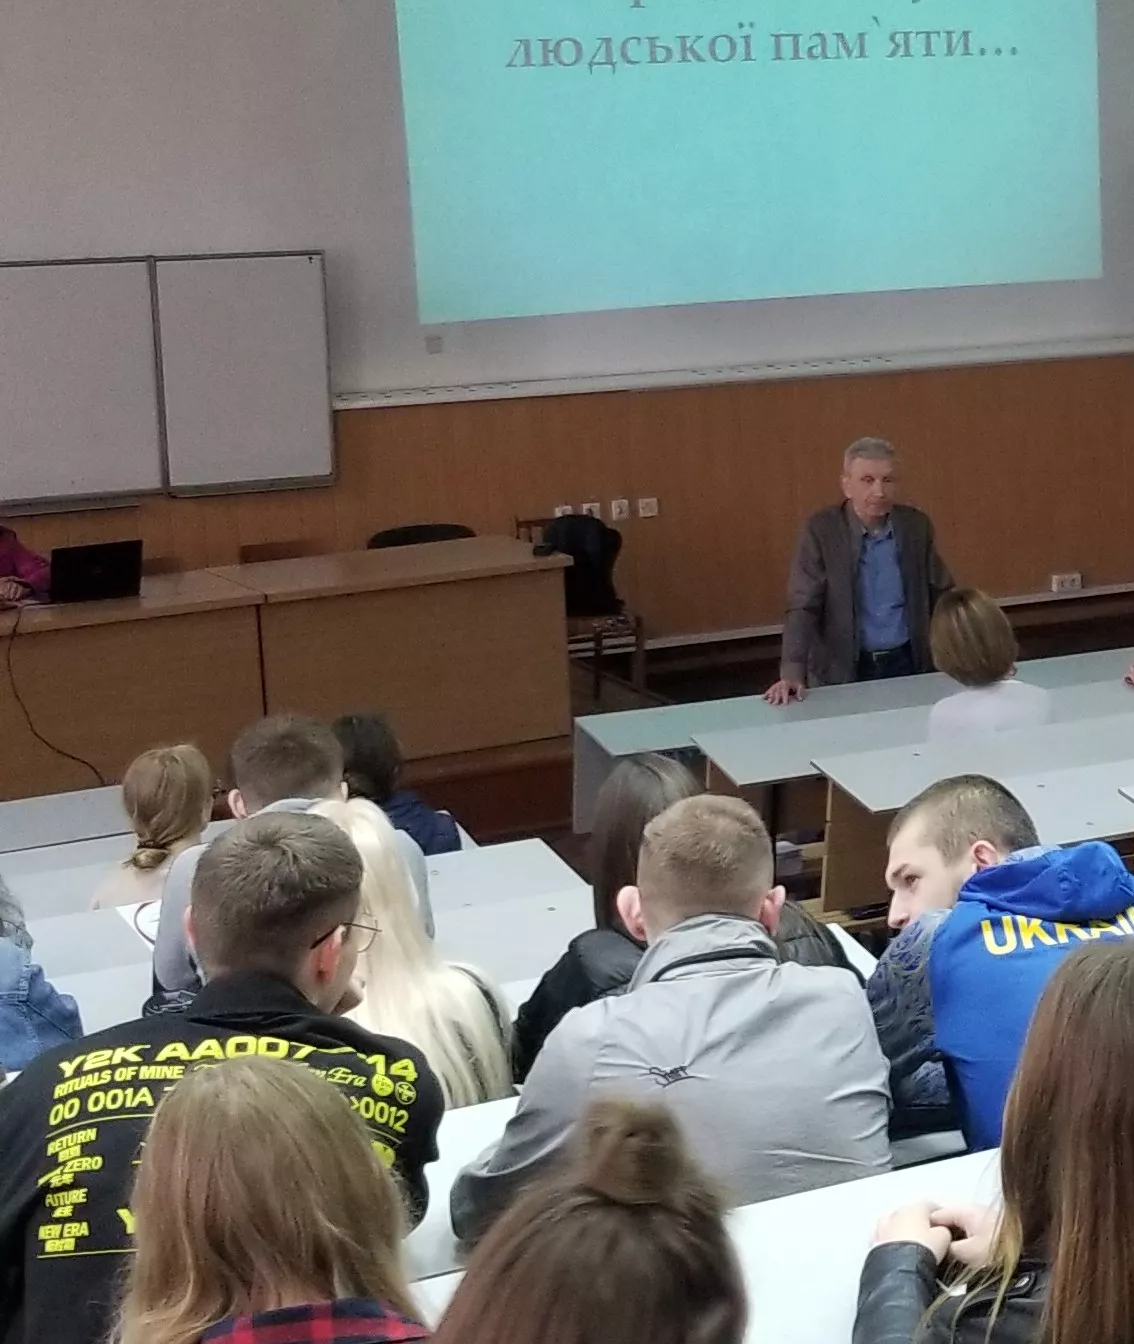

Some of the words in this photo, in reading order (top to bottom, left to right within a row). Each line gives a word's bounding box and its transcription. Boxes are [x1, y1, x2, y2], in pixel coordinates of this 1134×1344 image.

[505, 21, 757, 75] людської
[58, 1044, 151, 1078] Y2K
[53, 1069, 113, 1099] RITUALS
[113, 1066, 139, 1082] OF
[138, 1065, 186, 1080] MINE
[47, 1127, 98, 1156] RETURN
[63, 1156, 103, 1173] ZERO
[62, 1221, 90, 1237] ERA
